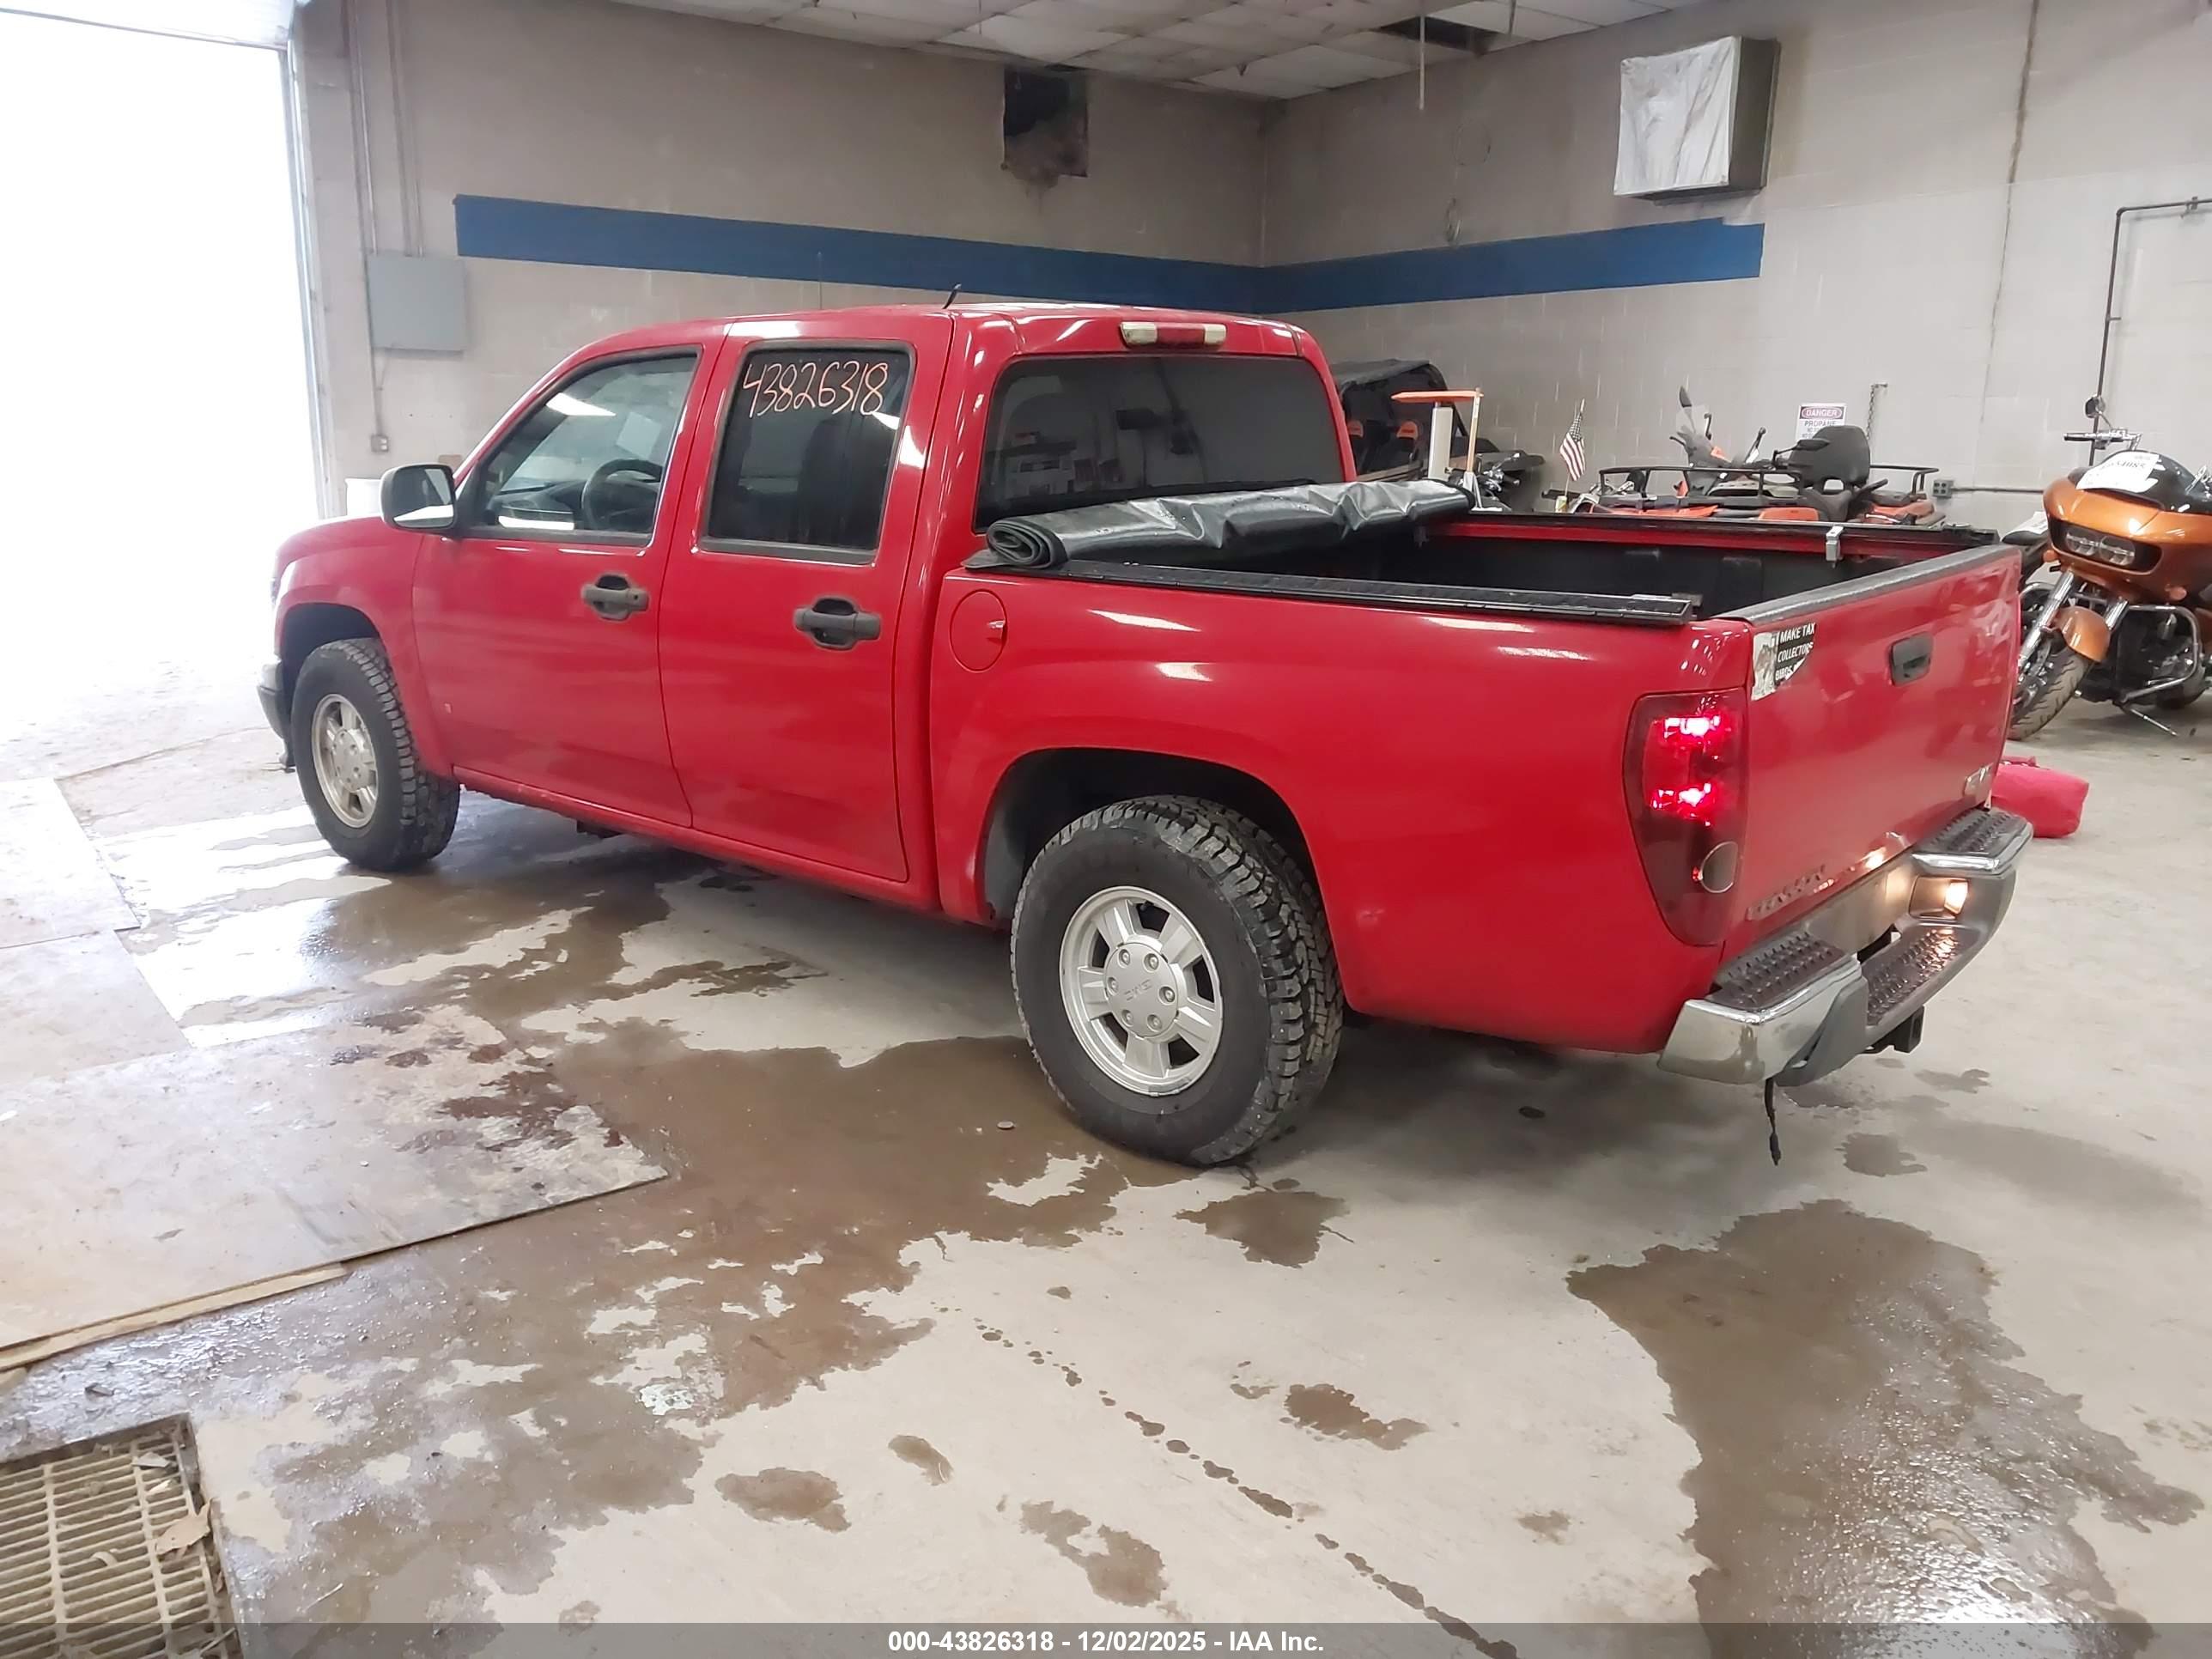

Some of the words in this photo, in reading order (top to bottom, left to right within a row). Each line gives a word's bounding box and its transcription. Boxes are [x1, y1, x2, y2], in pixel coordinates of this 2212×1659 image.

[744, 360, 889, 418] 43826318
[1806, 409, 1838, 417] DANGER
[1779, 626, 1802, 644] MAKE
[1802, 623, 1816, 637] TAX
